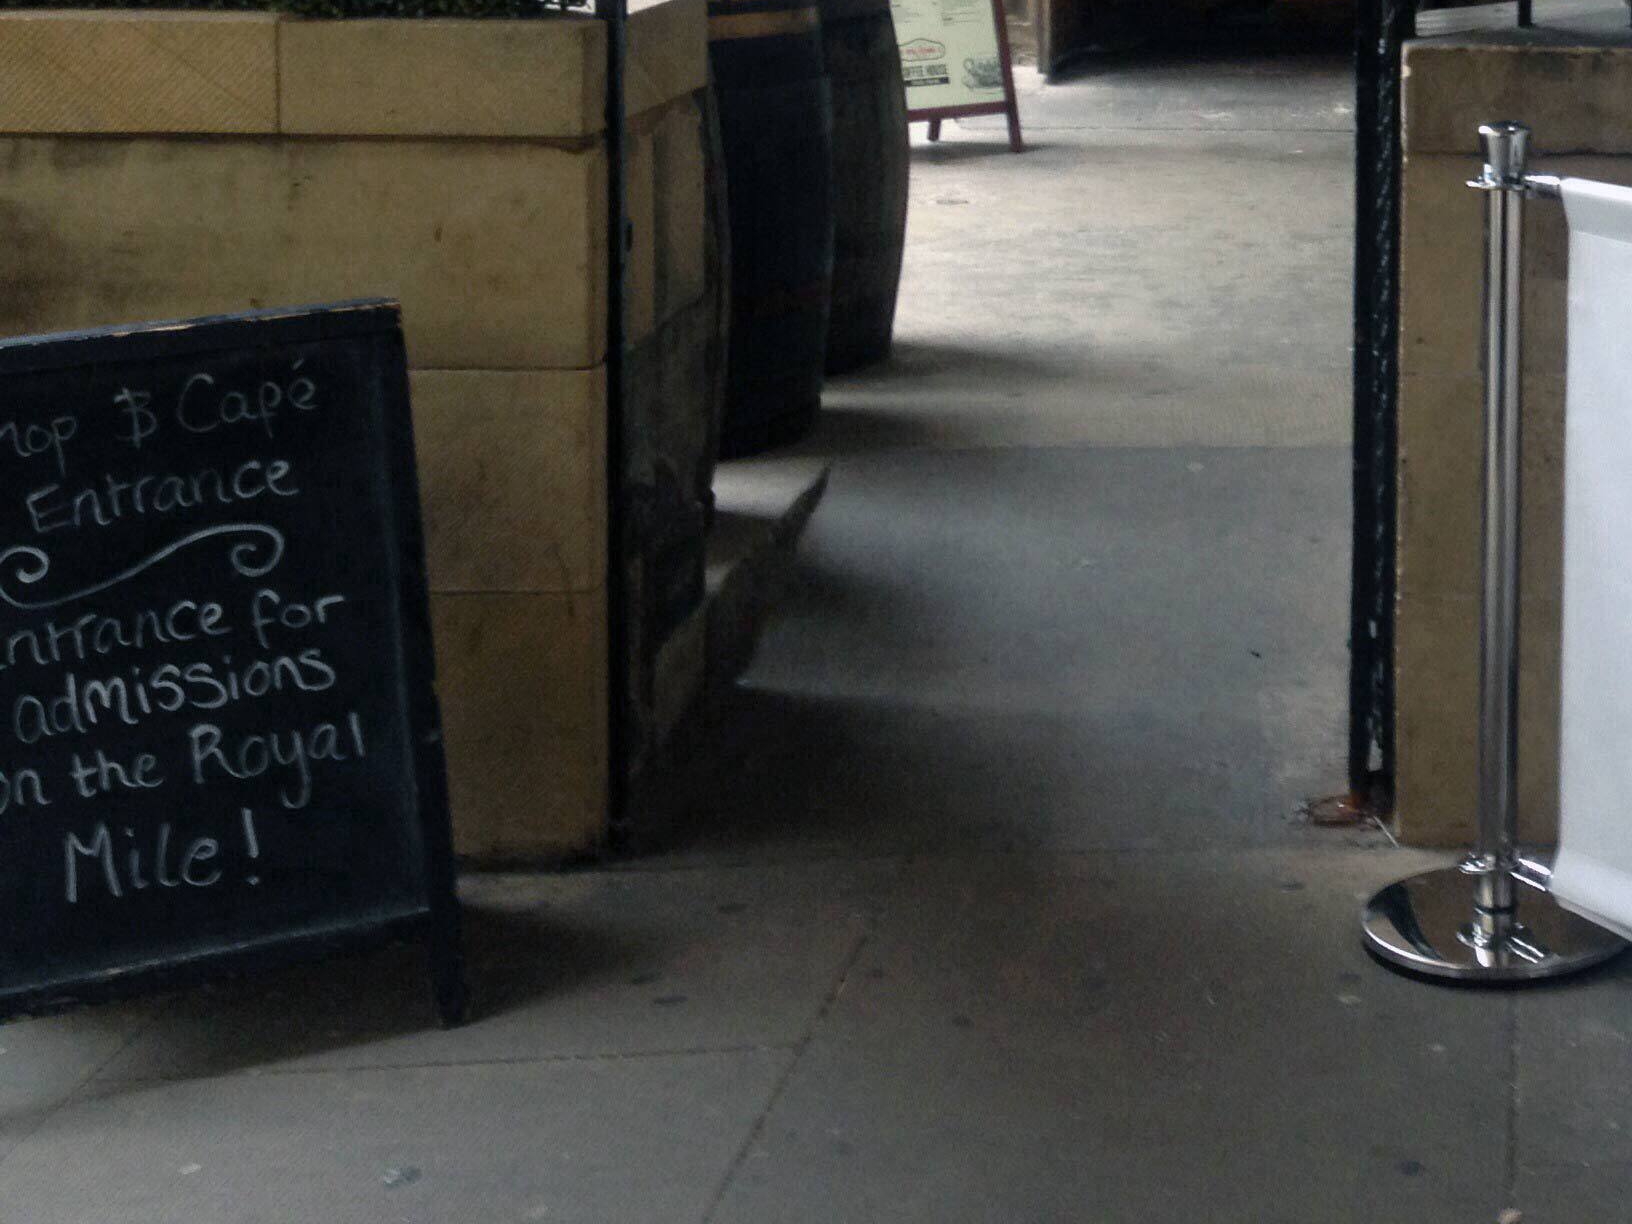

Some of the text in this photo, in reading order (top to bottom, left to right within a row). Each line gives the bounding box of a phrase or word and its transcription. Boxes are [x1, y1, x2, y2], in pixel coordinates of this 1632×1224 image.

[25, 459, 300, 534] Entrance
[0, 587, 346, 671] ntrance for
[13, 647, 337, 745] admissions
[71, 748, 165, 798] the
[188, 711, 367, 810] Royal
[64, 806, 261, 904] Mile!
